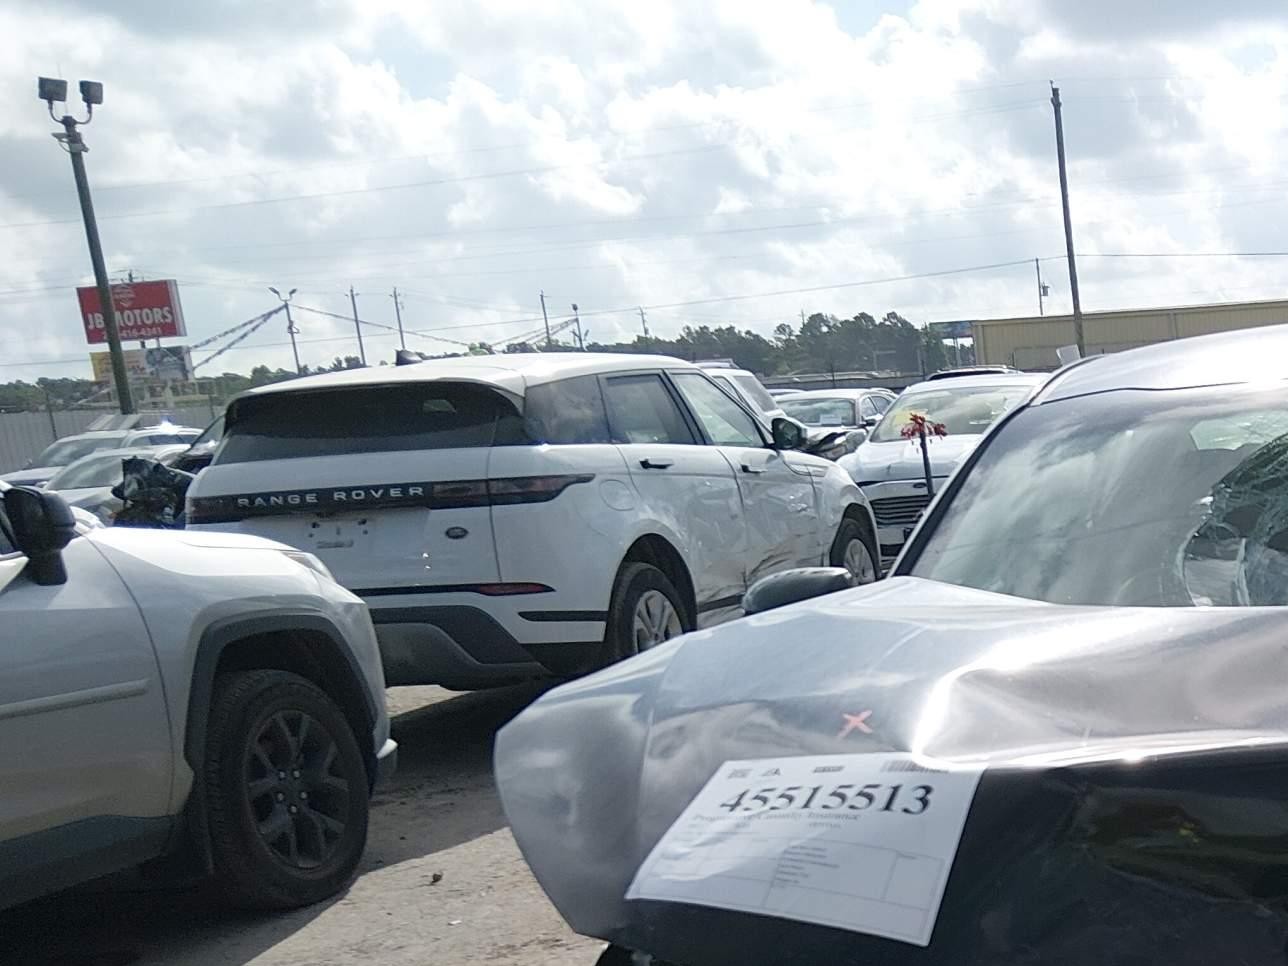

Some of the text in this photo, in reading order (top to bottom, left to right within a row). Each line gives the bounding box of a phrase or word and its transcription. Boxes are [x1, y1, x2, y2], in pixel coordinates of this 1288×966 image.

[238, 487, 424, 507] RANGE ROVER
[720, 784, 934, 815] 45515513
